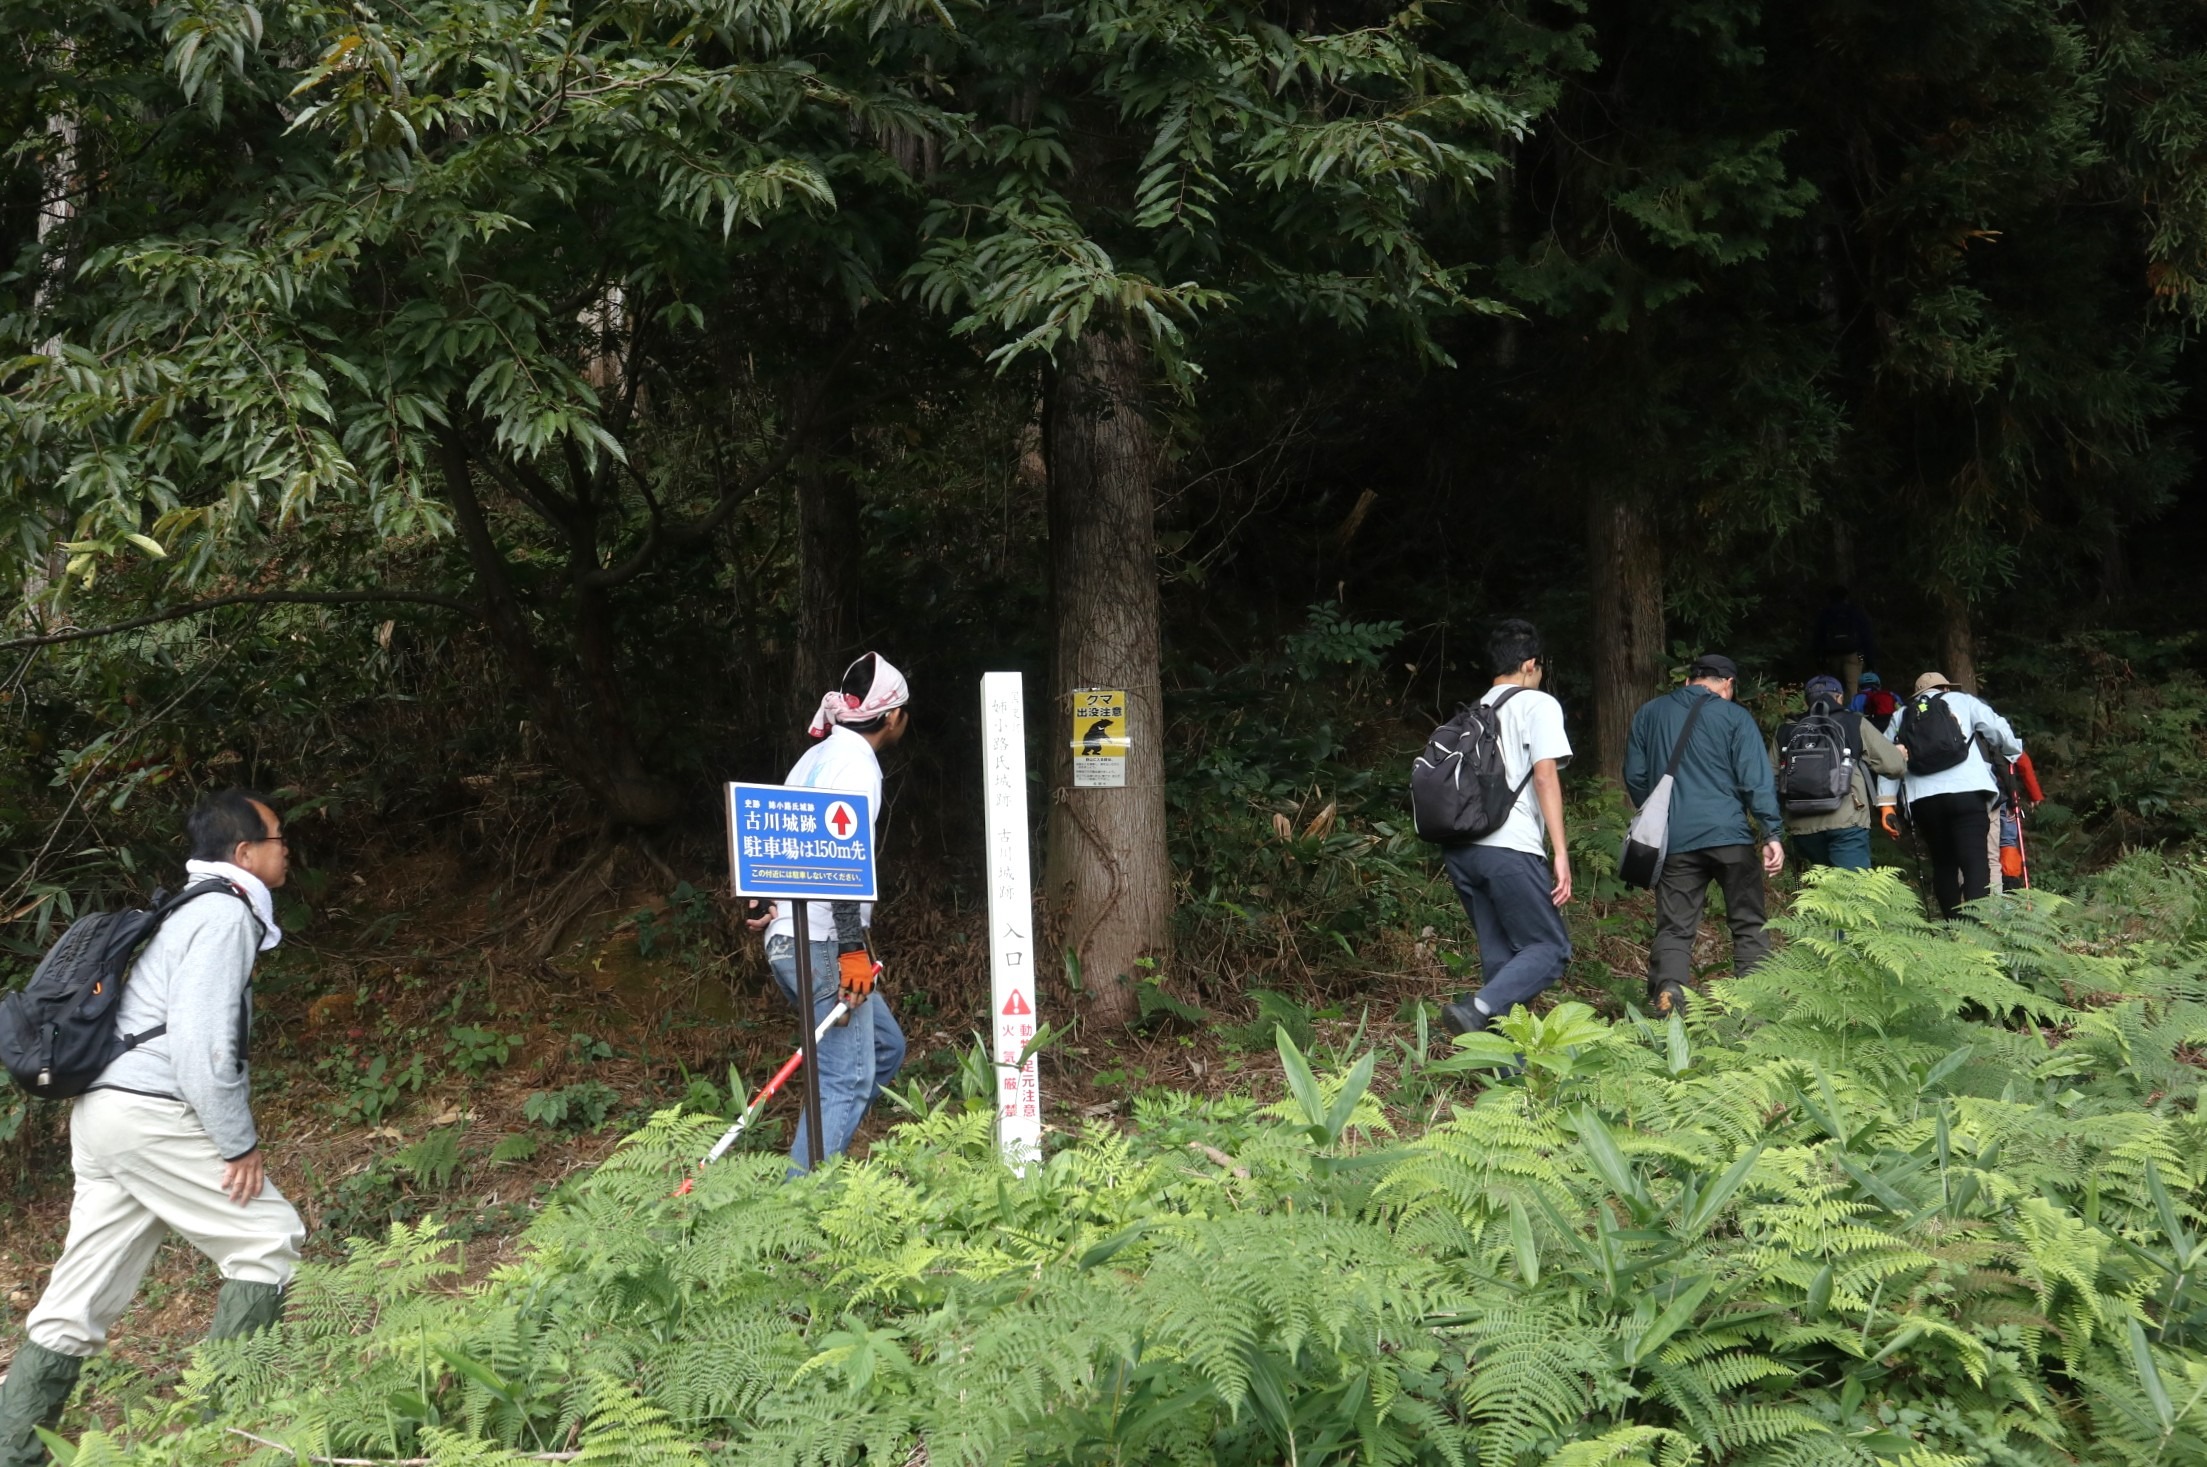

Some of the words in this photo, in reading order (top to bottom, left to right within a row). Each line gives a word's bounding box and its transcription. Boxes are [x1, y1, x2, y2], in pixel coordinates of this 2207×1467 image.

[1087, 695, 1112, 706] クマ
[1077, 707, 1122, 717] 出没注意
[745, 800, 760, 809] 史跡
[743, 811, 817, 833] 古川城跡
[743, 835, 866, 861] 駐車場は150m先
[752, 869, 861, 881] この付近には駐車しないでください。
[1003, 923, 1025, 967] 入口
